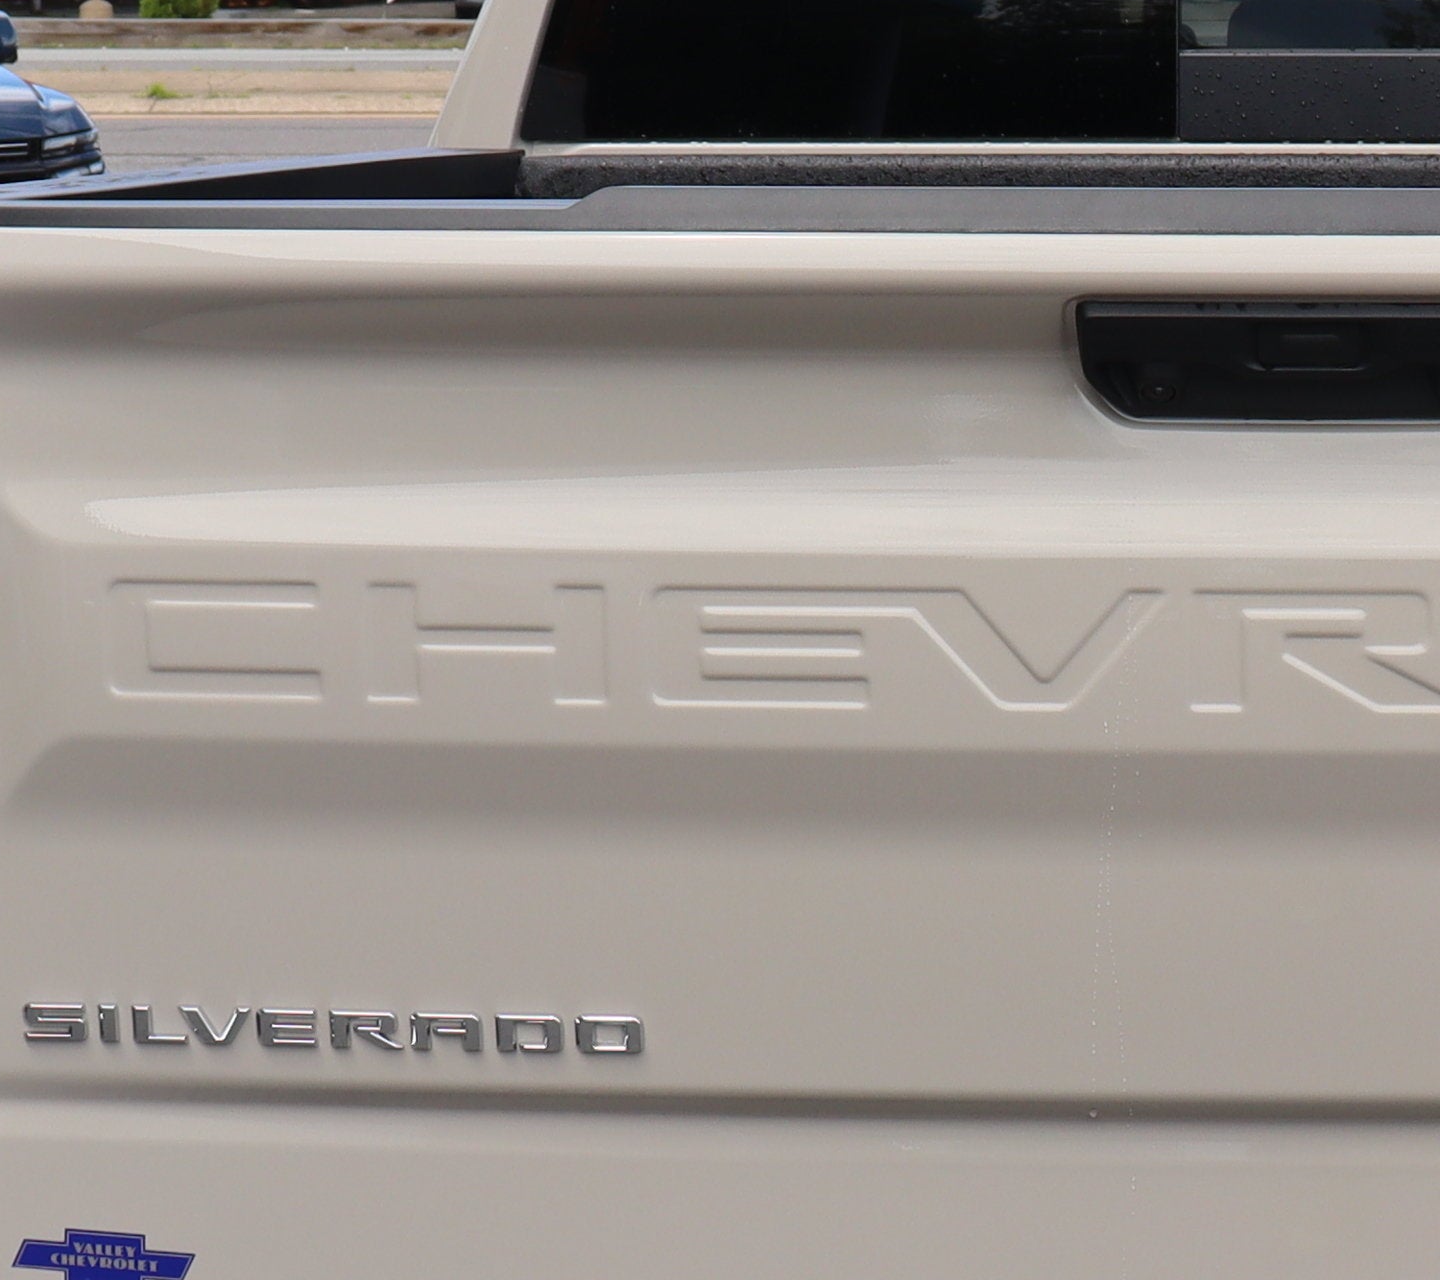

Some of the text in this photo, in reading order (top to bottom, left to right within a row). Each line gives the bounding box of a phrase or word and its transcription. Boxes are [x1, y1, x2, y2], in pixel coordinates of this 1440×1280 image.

[24, 1002, 645, 1054] SILVERADO
[73, 1241, 137, 1258] VALLEY
[50, 1252, 159, 1273] CHEVROLET
